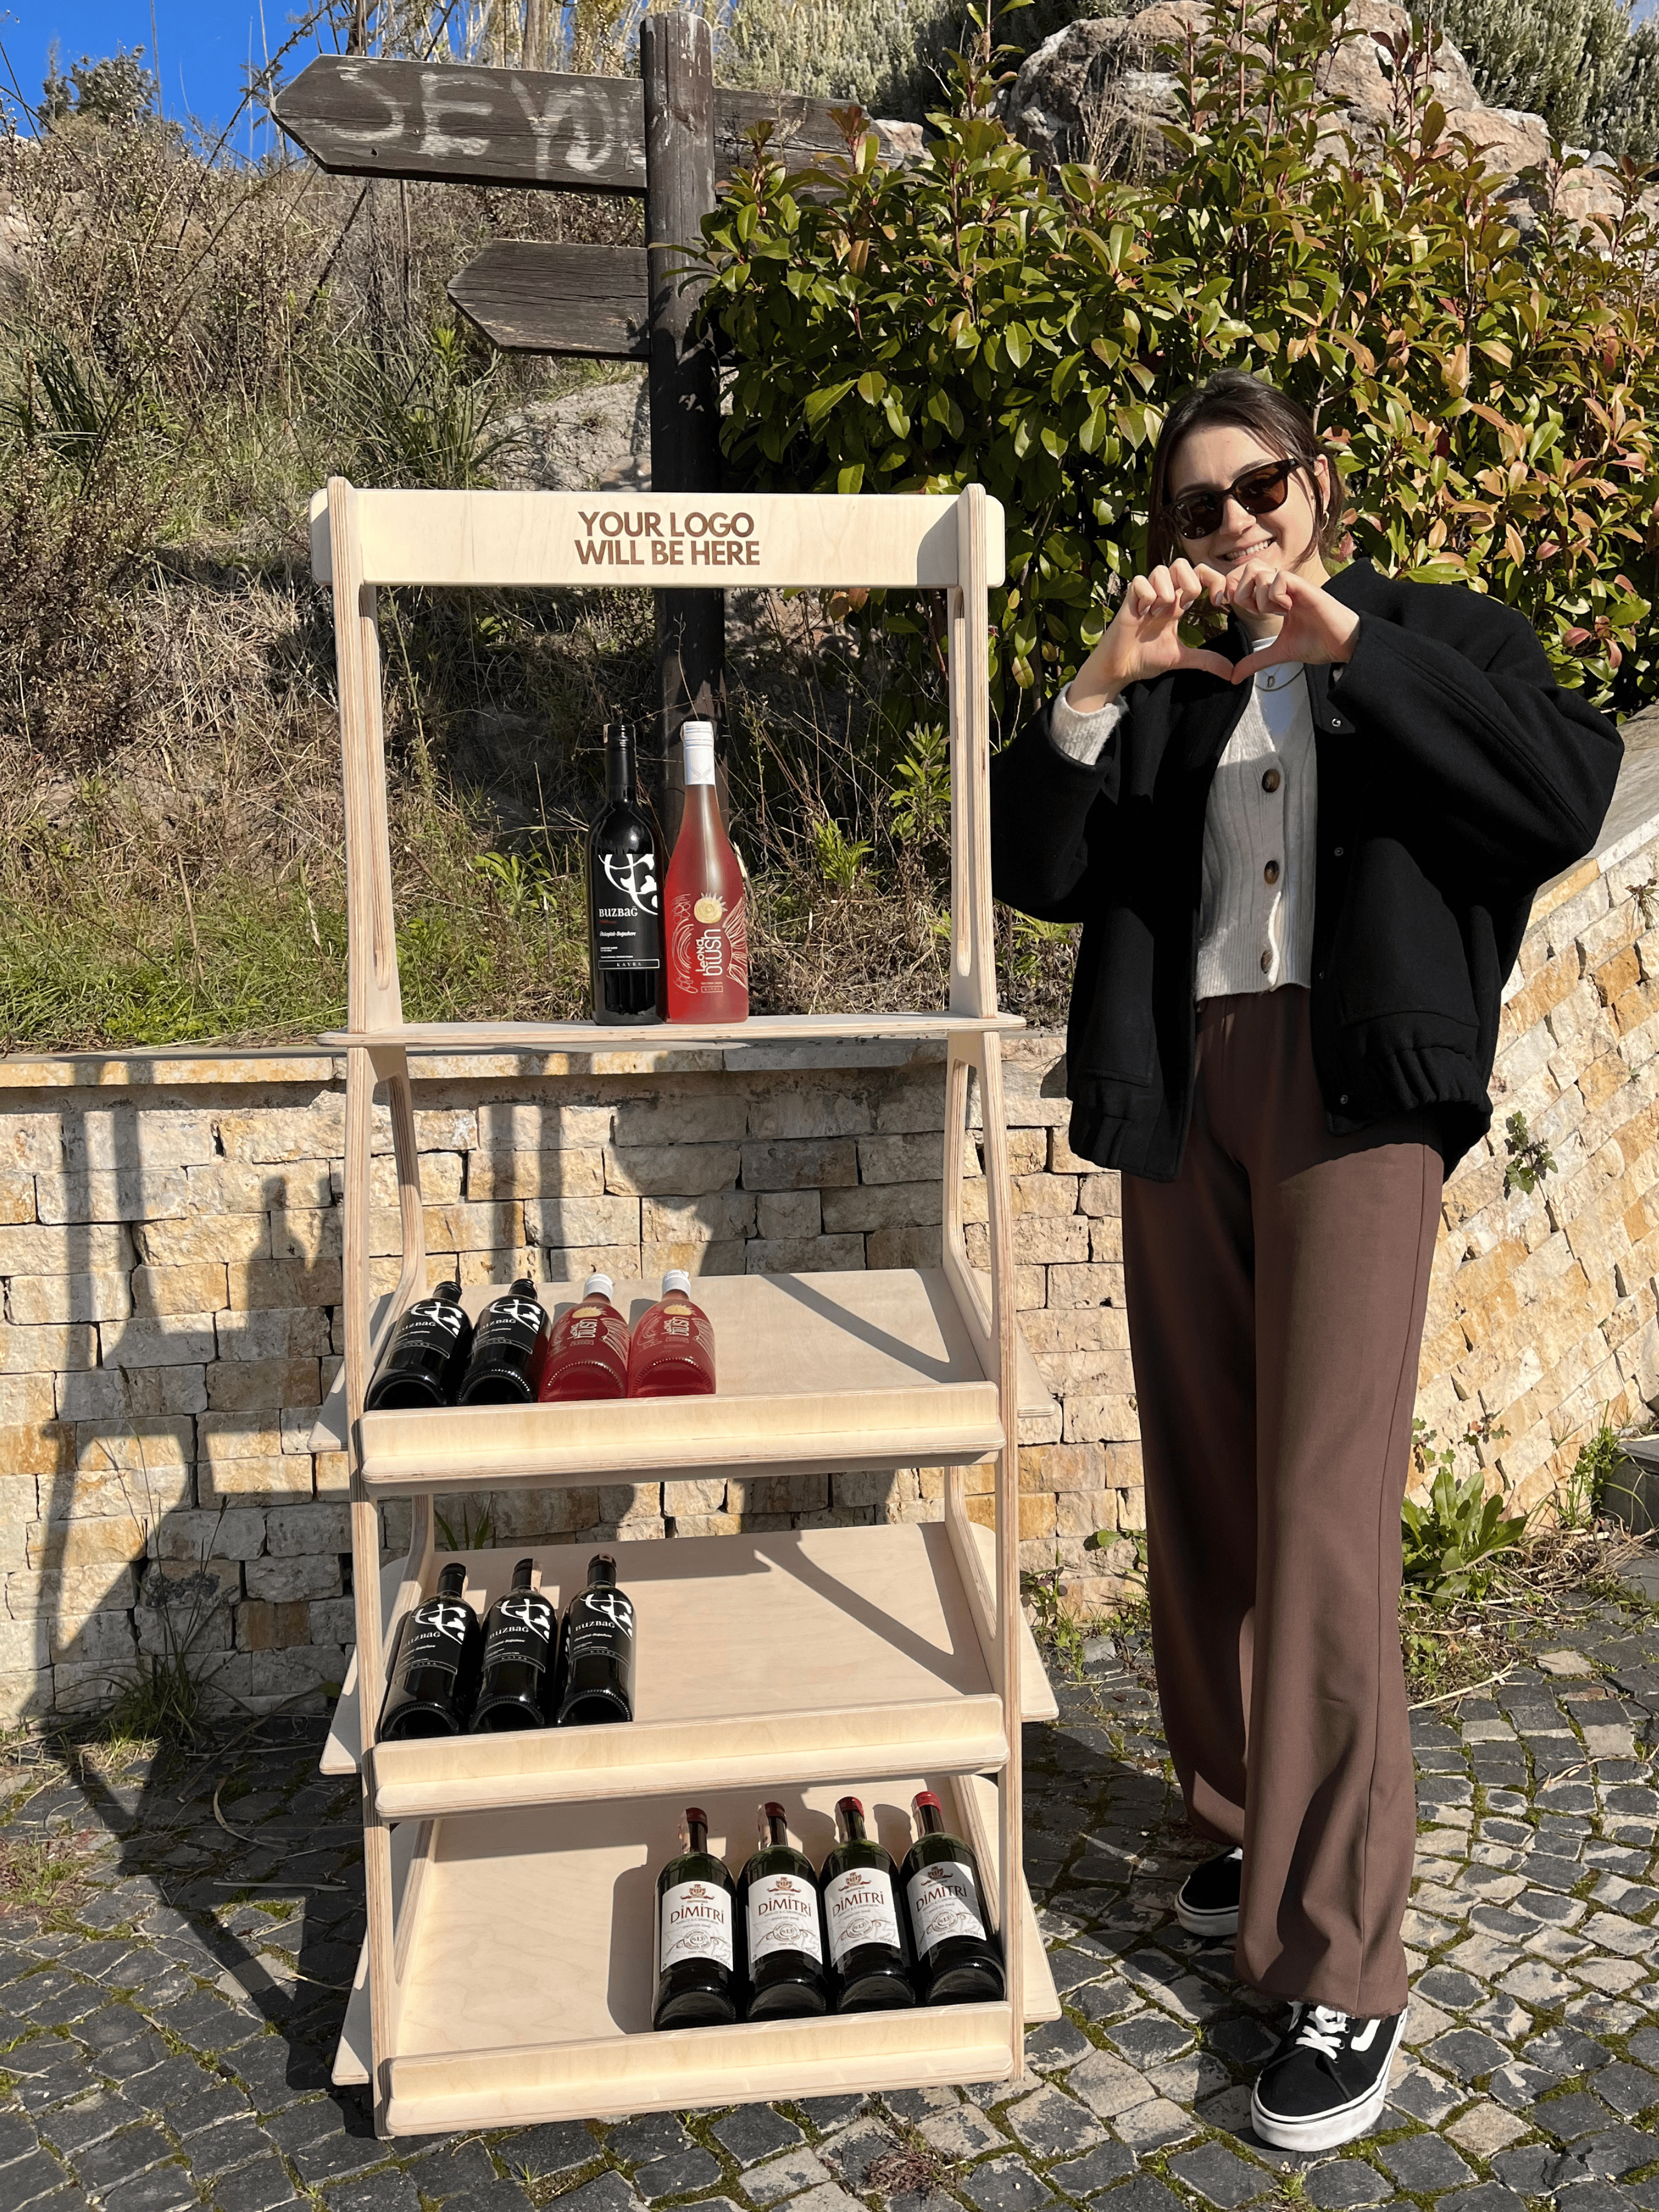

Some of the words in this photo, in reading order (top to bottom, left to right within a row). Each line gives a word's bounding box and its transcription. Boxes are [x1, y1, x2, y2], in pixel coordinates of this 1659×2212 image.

[578, 511, 664, 537] YOUR
[670, 512, 754, 537] LOGO
[574, 540, 644, 565] WILL
[652, 540, 684, 565] BE
[691, 540, 760, 565] HERE
[701, 929, 723, 976] blush
